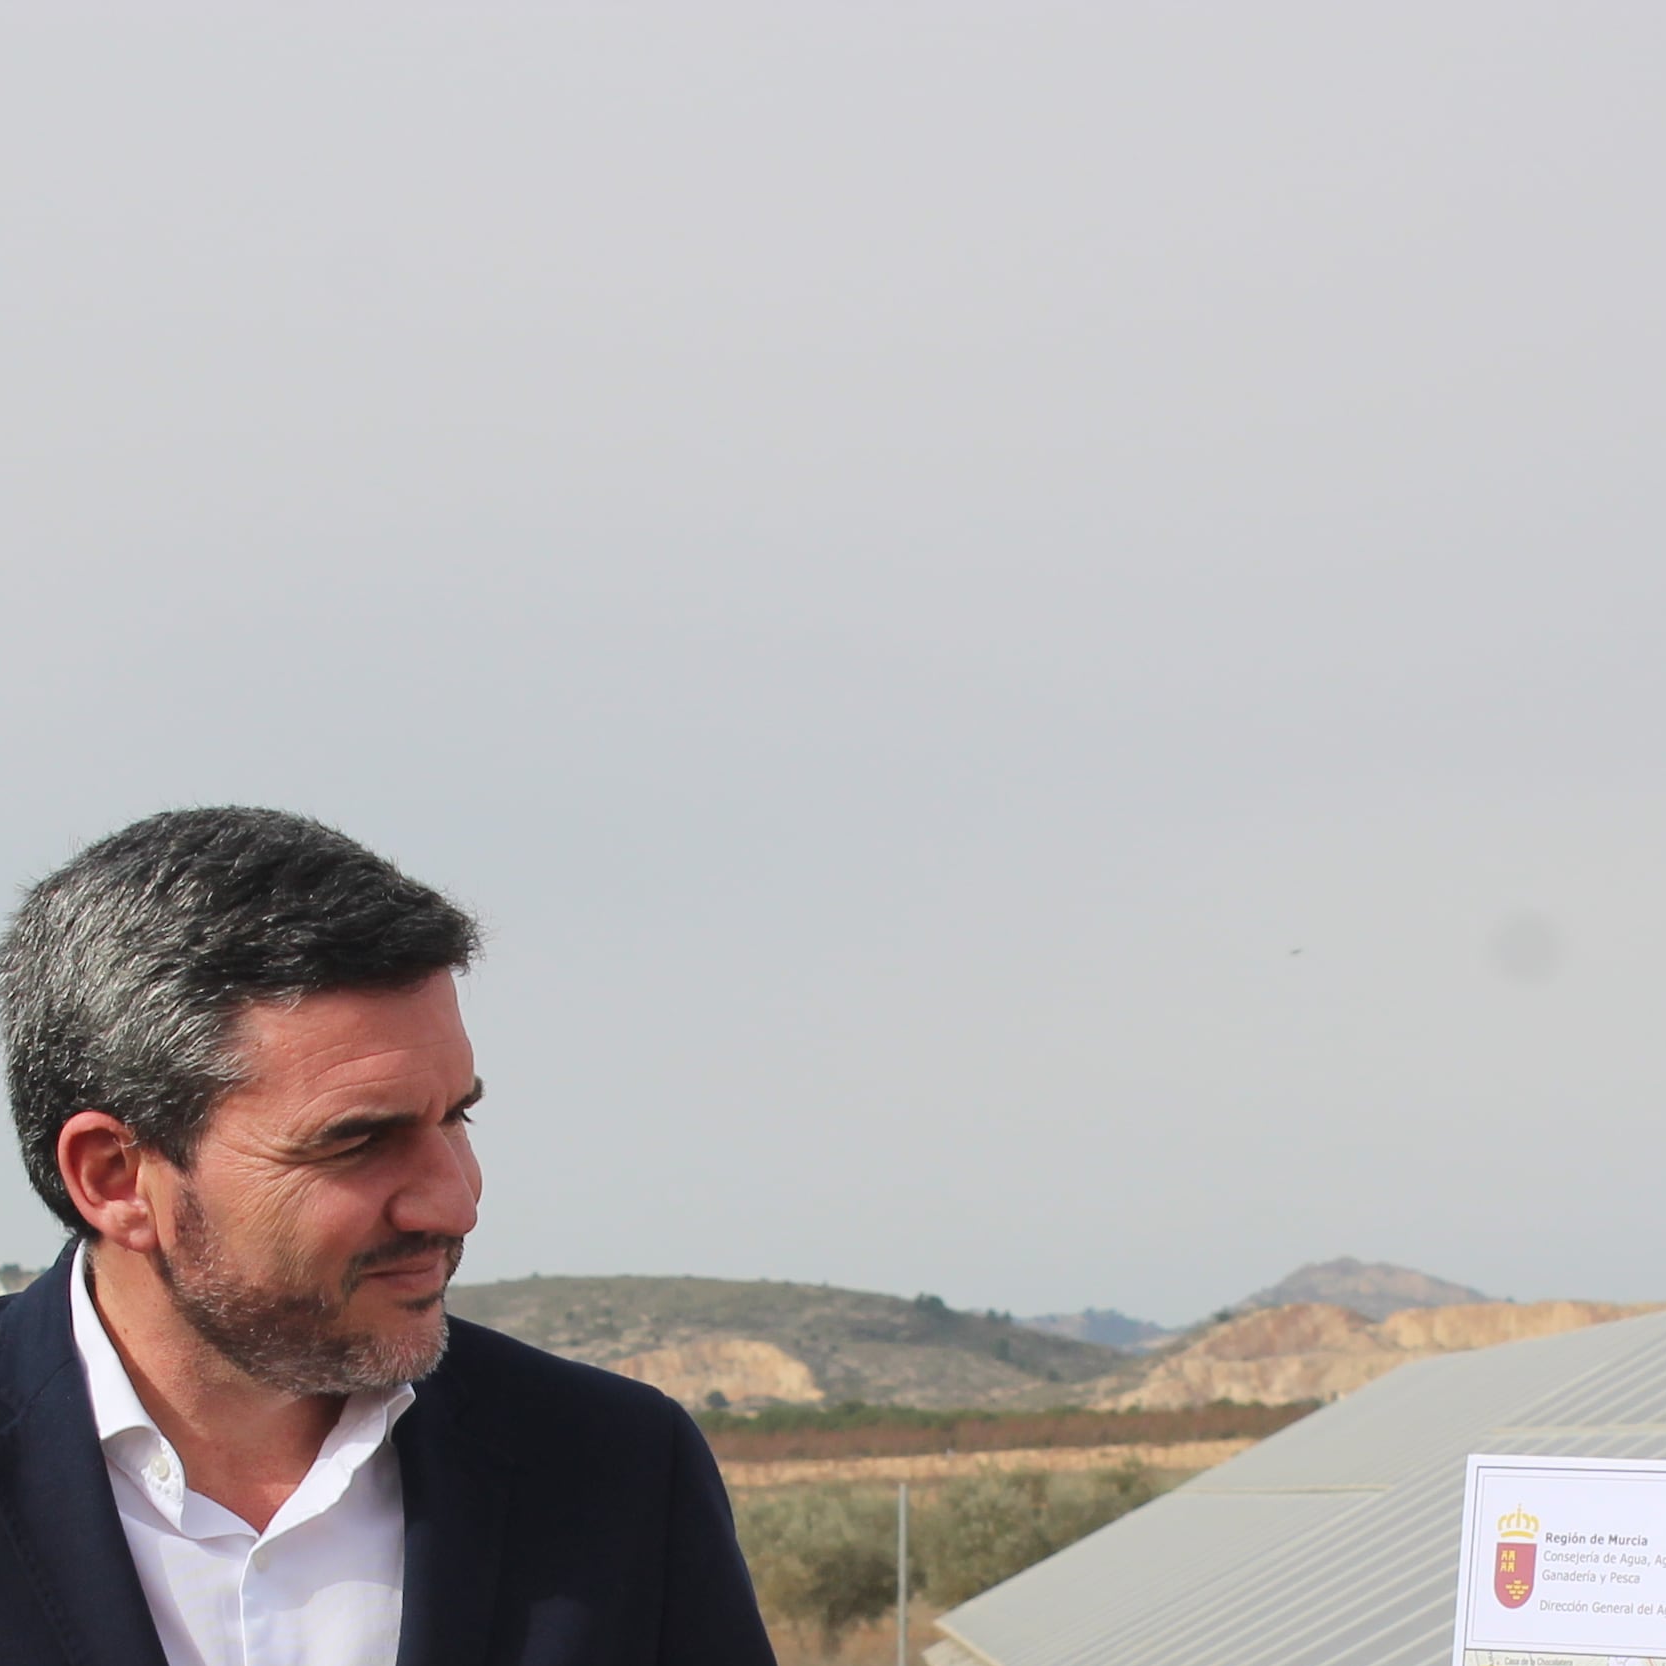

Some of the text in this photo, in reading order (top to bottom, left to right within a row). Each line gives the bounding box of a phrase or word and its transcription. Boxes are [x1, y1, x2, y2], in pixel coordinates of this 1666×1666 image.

[1545, 1532, 1648, 1548] Región de Murcia
[1543, 1550, 1600, 1566] Consejería
[1603, 1552, 1617, 1564] de
[1619, 1553, 1651, 1567] Agua,
[1541, 1570, 1641, 1585] Ganadería y Pesca
[1539, 1599, 1589, 1613] Dirección
[1592, 1602, 1634, 1615] General
[1637, 1603, 1654, 1615] del
